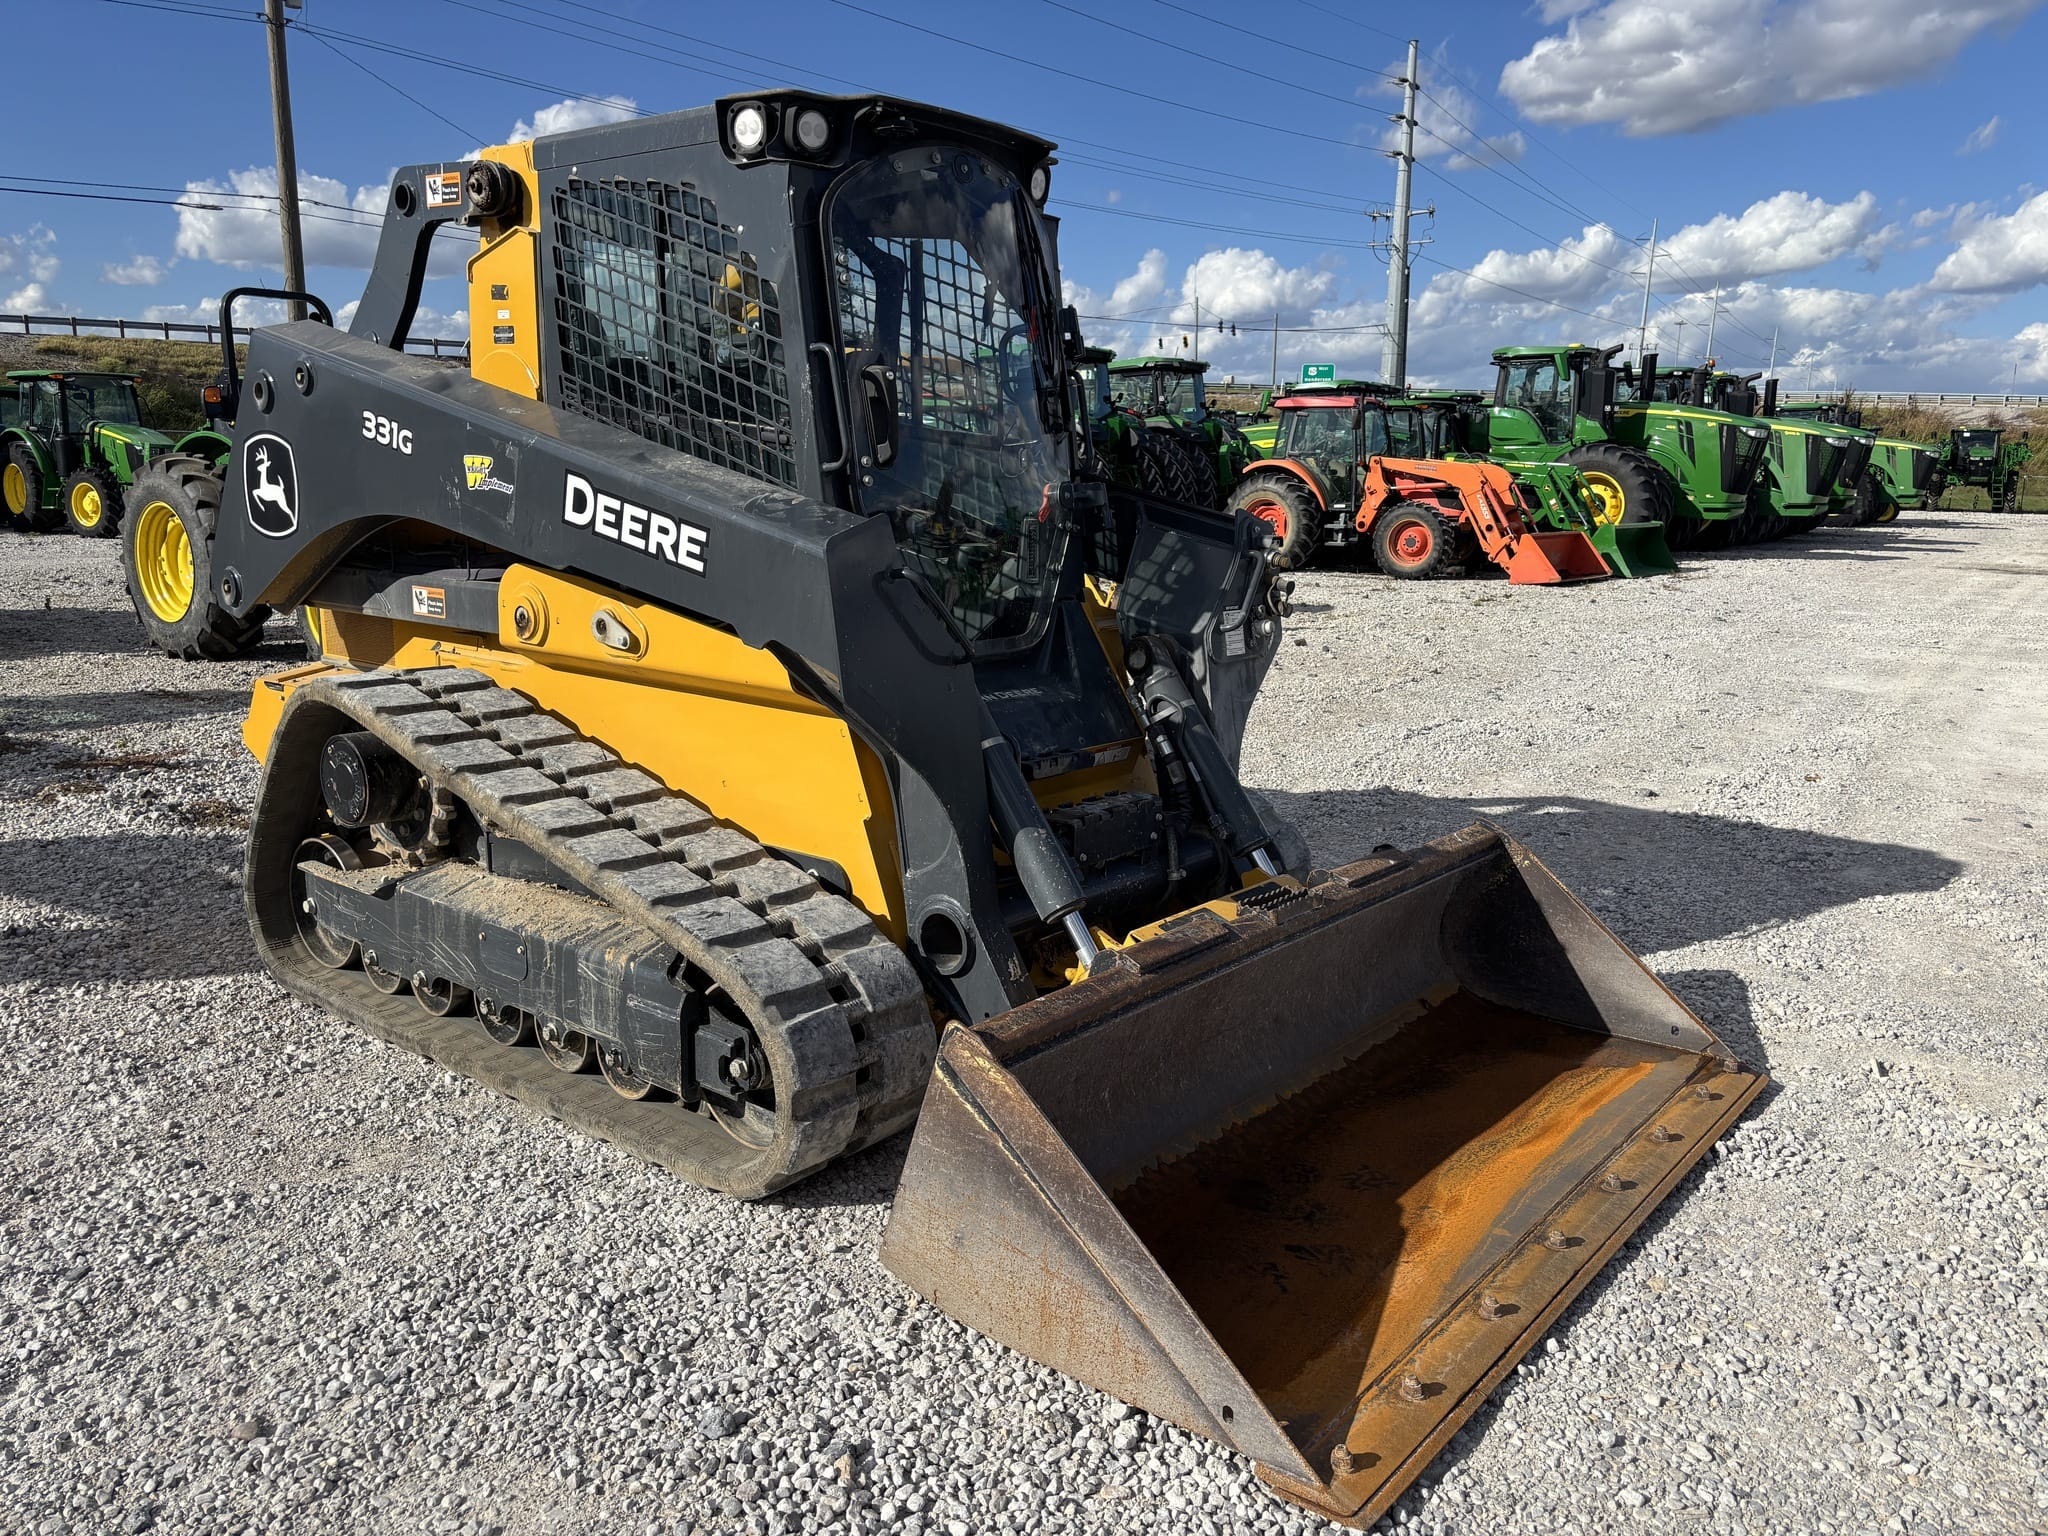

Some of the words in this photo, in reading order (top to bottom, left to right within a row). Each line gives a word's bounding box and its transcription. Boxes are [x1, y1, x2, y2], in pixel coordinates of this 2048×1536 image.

[362, 410, 413, 455] 331G
[477, 478, 513, 494] Implement
[564, 473, 707, 573] DEERE
